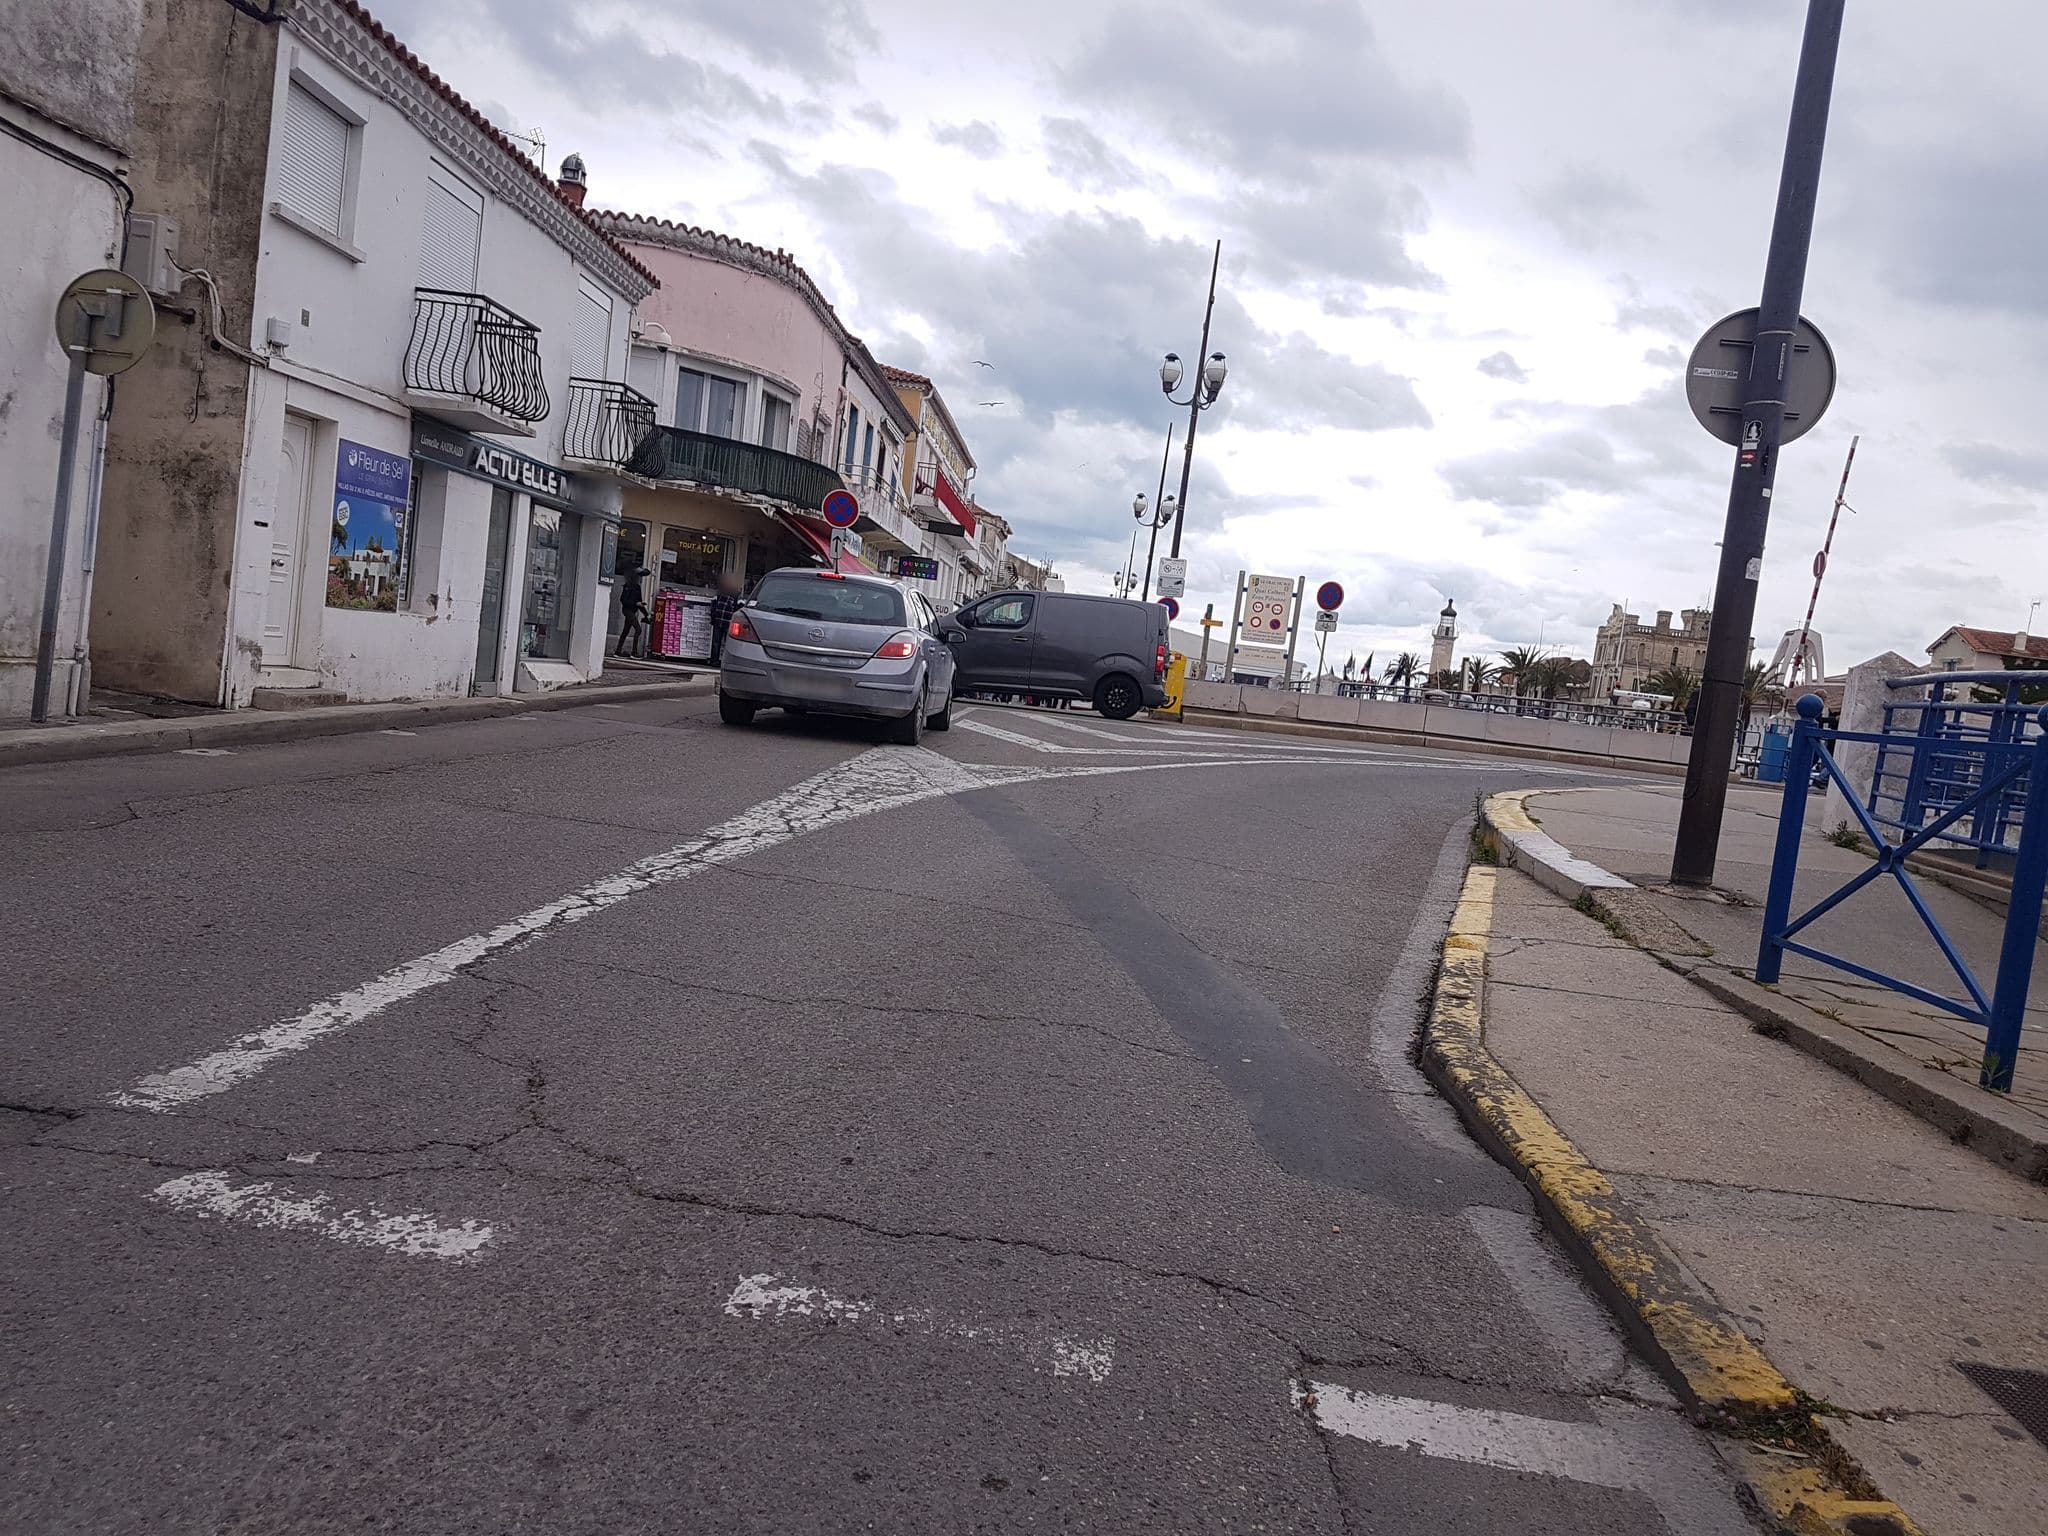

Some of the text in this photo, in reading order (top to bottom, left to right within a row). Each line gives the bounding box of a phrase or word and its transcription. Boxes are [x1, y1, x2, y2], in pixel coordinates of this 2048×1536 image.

[358, 450, 379, 473] Fleur
[380, 459, 391, 476] de
[391, 461, 404, 480] Sel
[679, 541, 697, 550] TOUT
[702, 543, 721, 554] 10€
